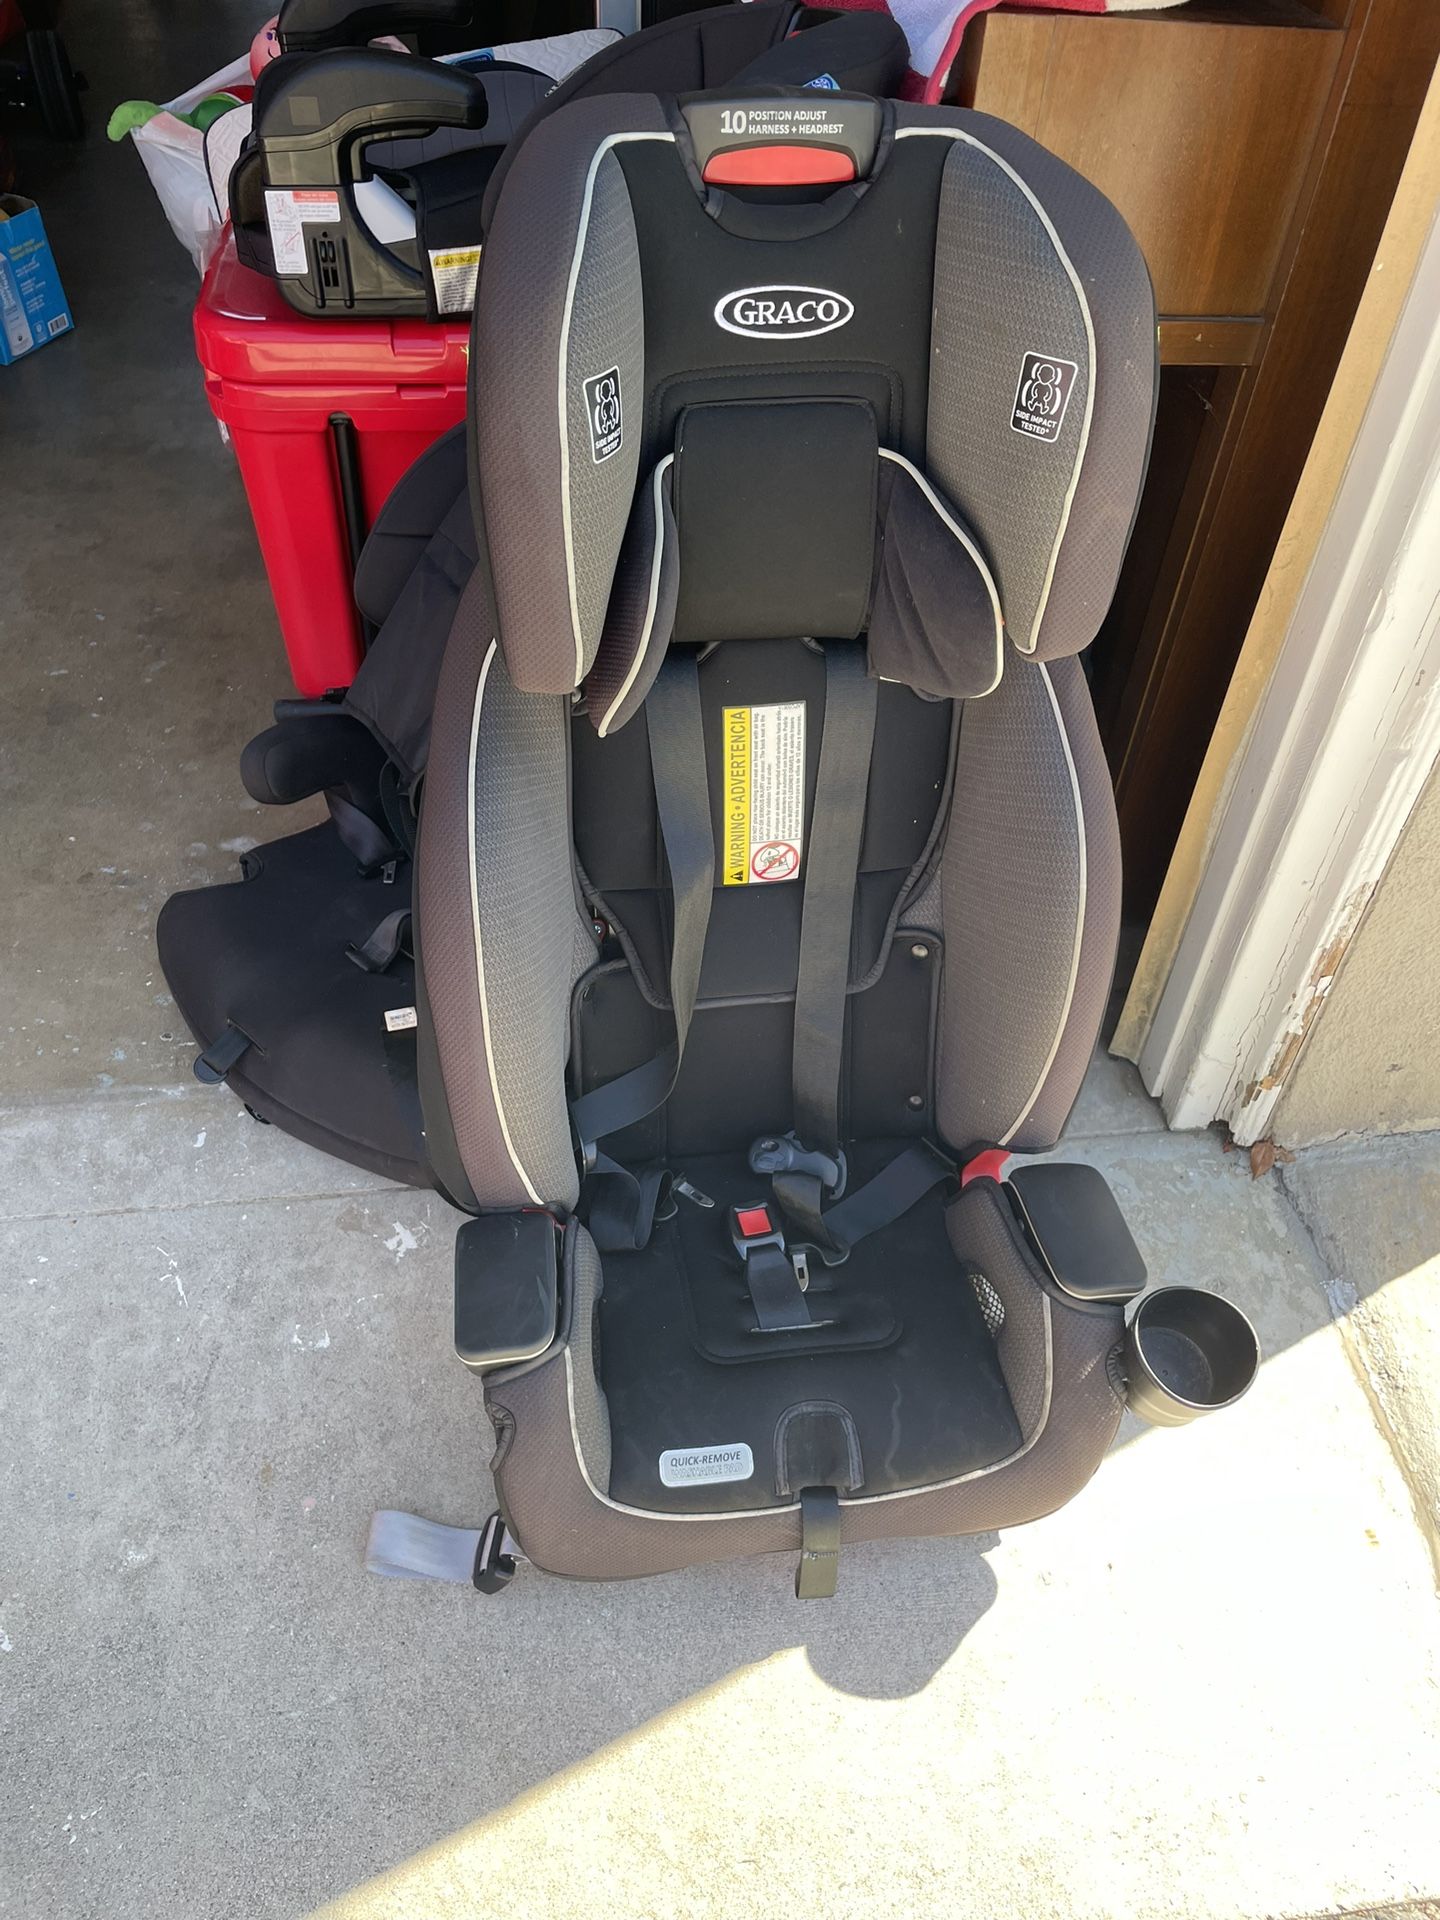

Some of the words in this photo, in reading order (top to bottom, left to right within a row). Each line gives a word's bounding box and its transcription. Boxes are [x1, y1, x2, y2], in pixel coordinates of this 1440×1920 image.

[720, 110, 747, 134] 10
[749, 110, 792, 121] POSITION
[793, 110, 828, 121] ADJUST
[748, 124, 790, 134] HARNESS
[799, 123, 844, 134] HEADREST
[733, 298, 840, 325] GRACO
[1015, 409, 1029, 421] SIDE
[1030, 413, 1058, 428] IMPACT
[729, 710, 746, 803] ADVERTENCIA
[729, 812, 746, 869] WARNING
[670, 1450, 741, 1467] QUICK-REMOVE
